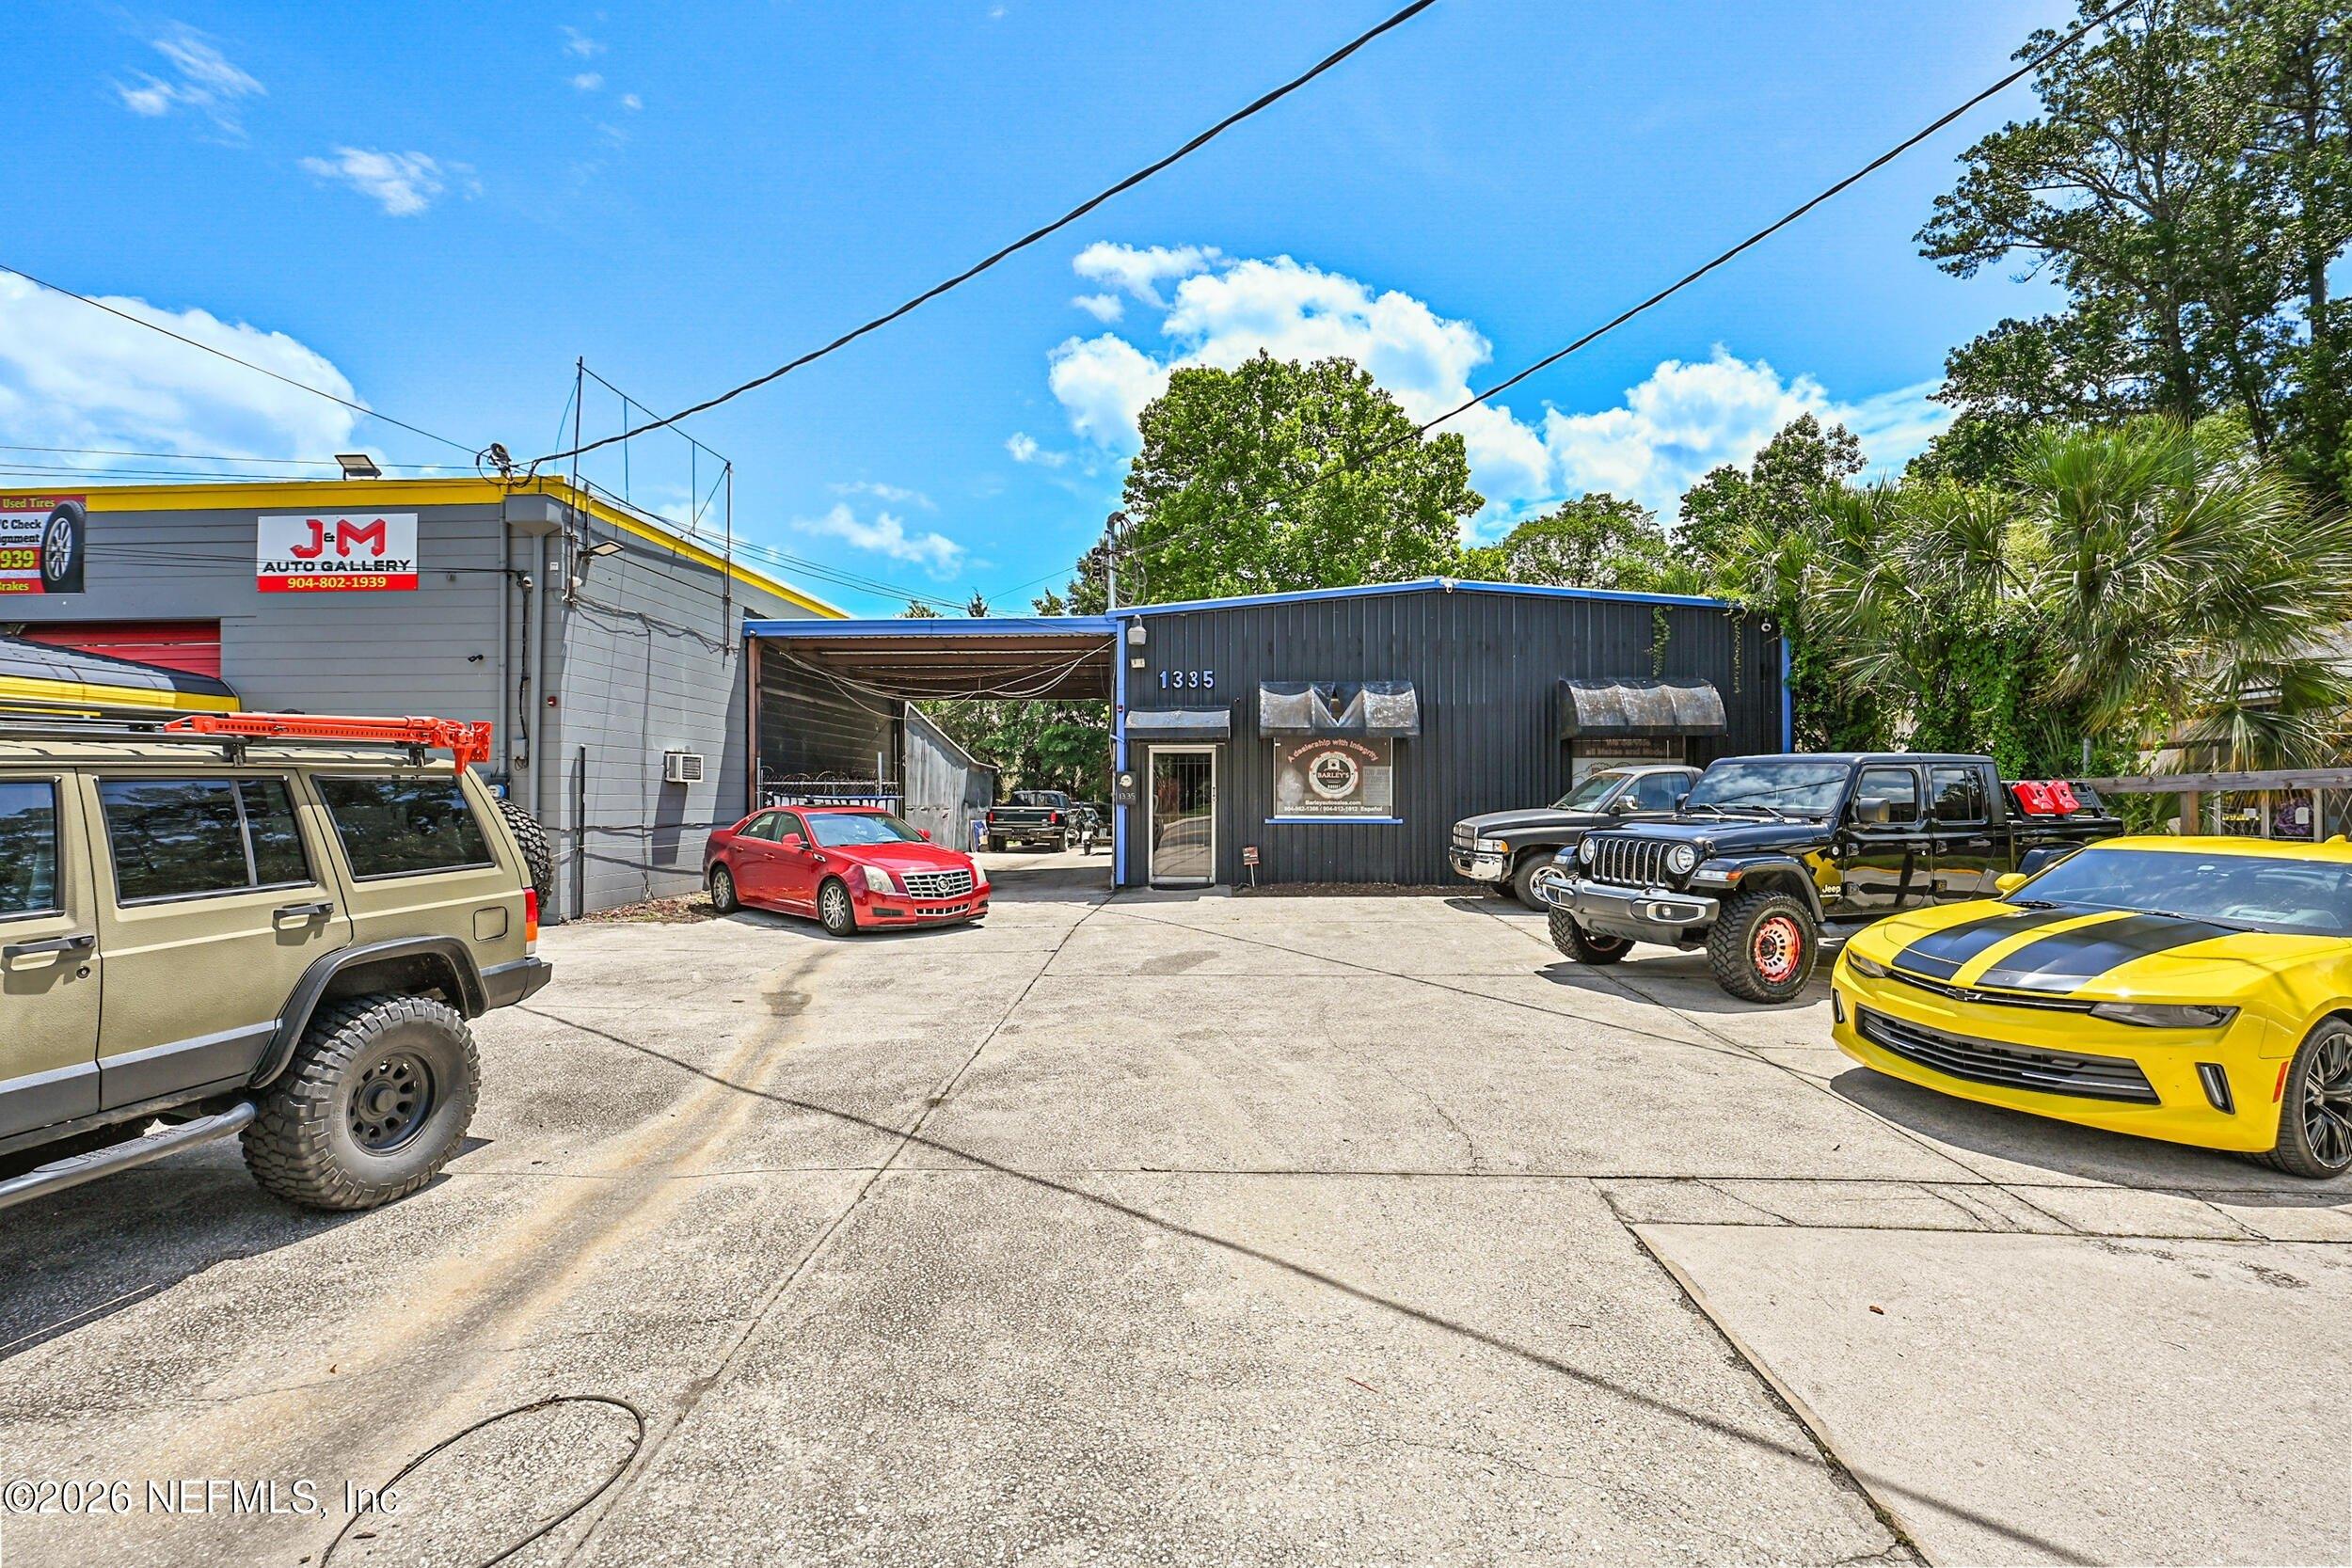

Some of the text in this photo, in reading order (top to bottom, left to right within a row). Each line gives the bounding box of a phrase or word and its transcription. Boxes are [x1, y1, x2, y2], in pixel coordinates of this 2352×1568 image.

[3, 498, 56, 508] Used Tires
[10, 518, 41, 530] Check
[290, 518, 386, 559] J&M
[262, 560, 411, 573] AUTO GALLERY
[287, 577, 387, 589] 904-802-1939
[1159, 670, 1215, 689] 1335
[1294, 738, 1331, 758] dealership
[1332, 738, 1348, 747] with
[1821, 884, 1841, 894] Jeep
